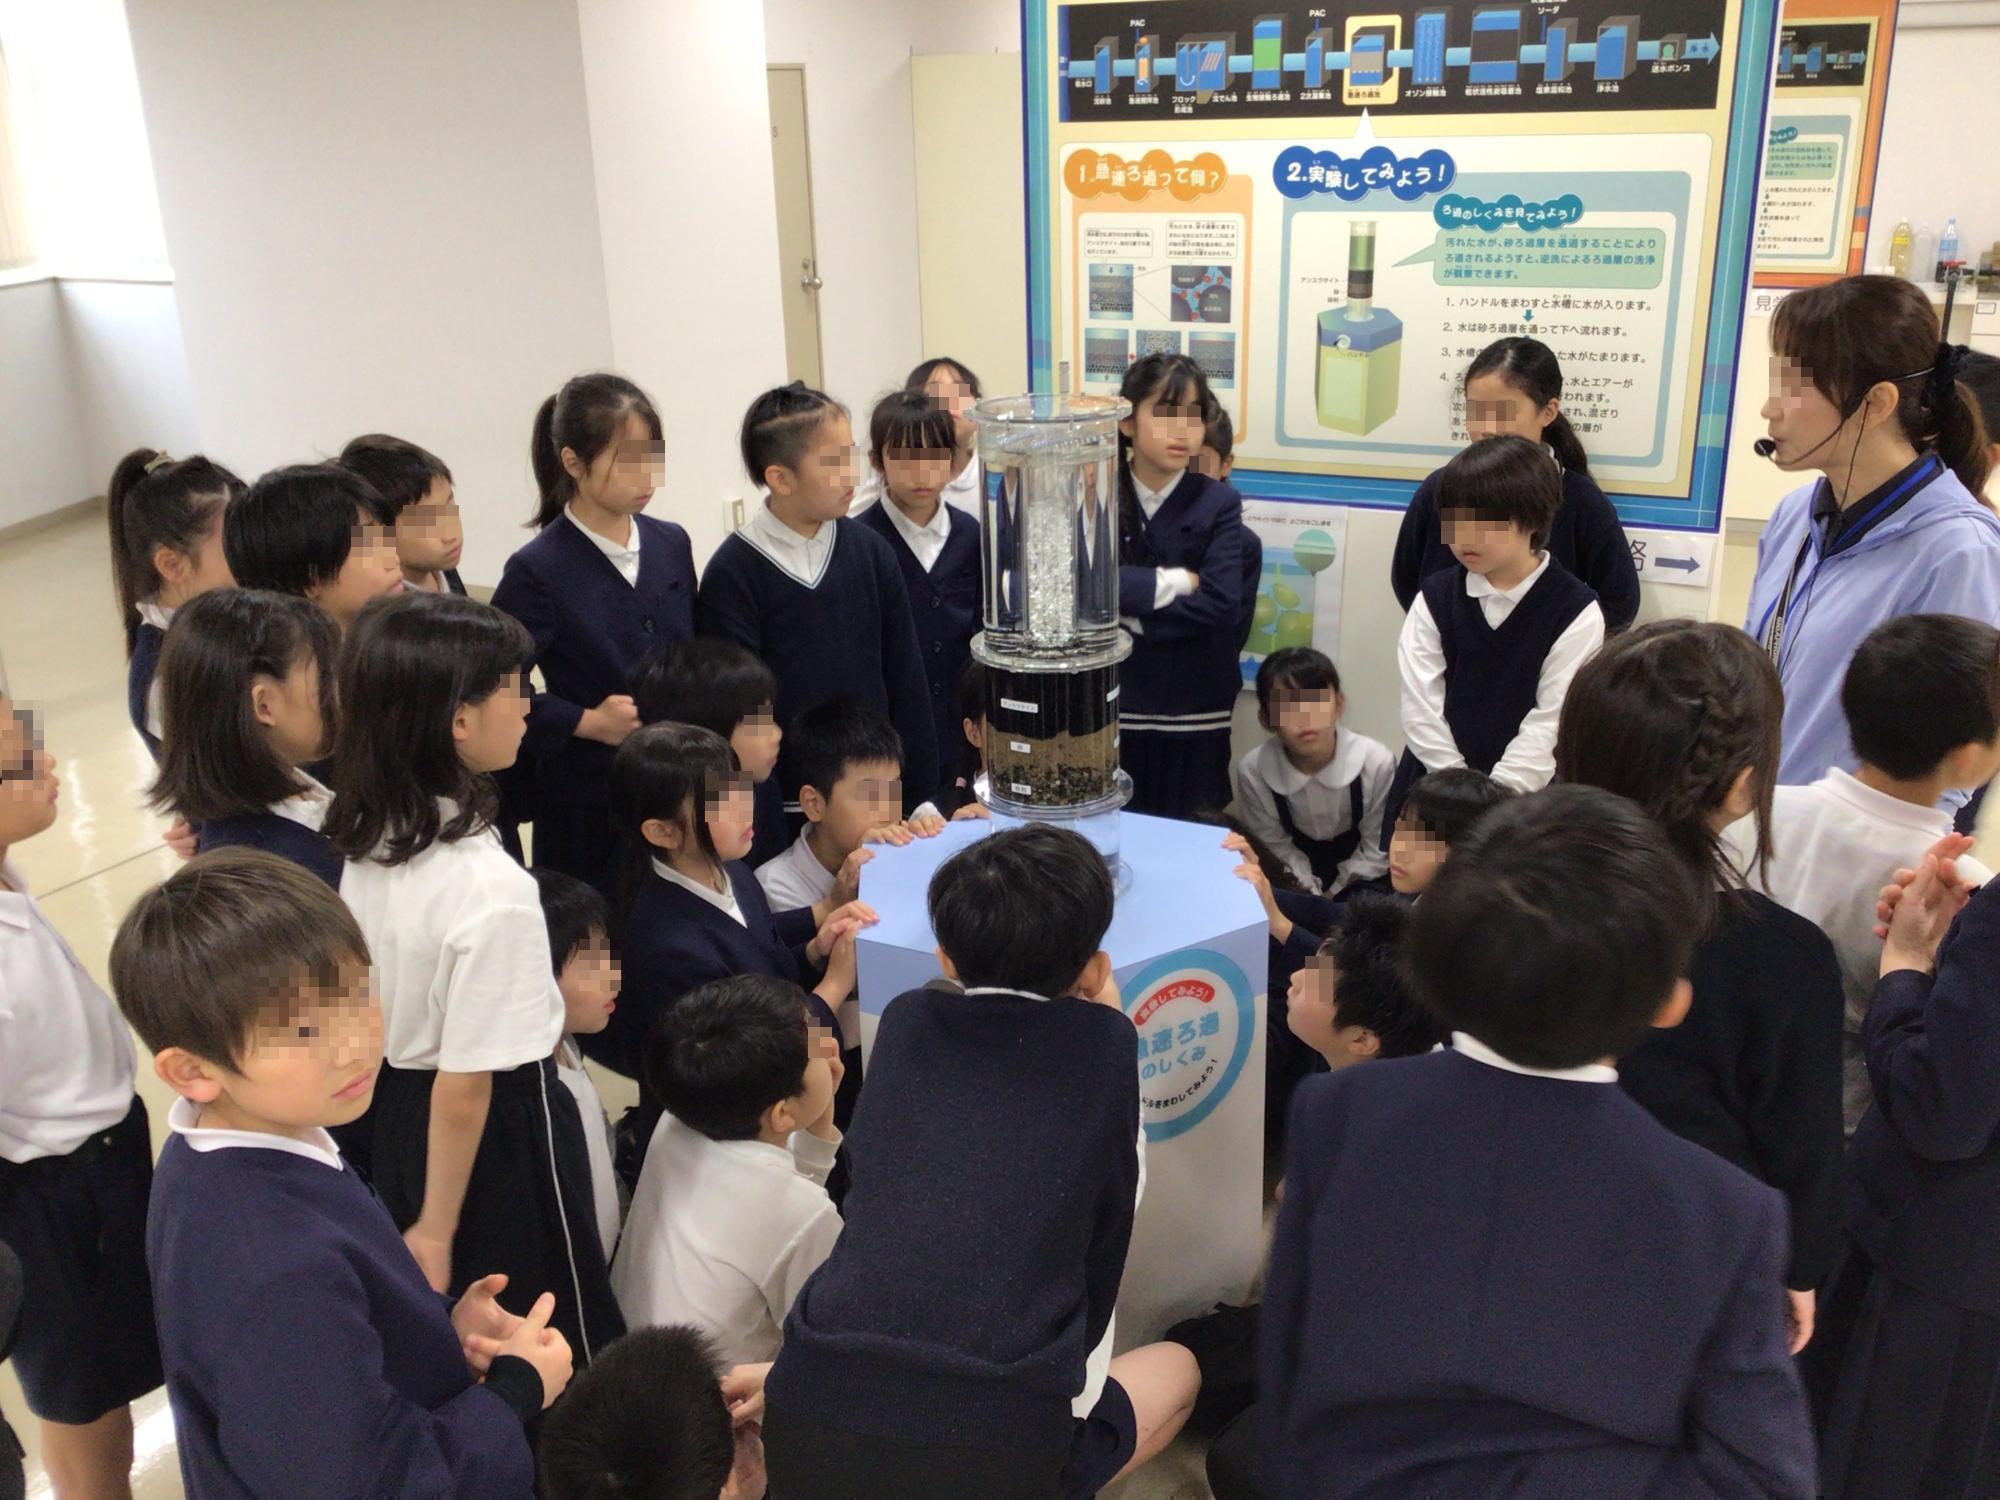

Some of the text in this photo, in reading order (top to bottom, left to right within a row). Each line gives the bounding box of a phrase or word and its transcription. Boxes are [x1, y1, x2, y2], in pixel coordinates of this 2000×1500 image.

[1309, 9, 1326, 17] PAC
[1537, 5, 1560, 15] ソーダ
[1130, 19, 1145, 27] PAC
[1172, 96, 1196, 104] フロック
[1555, 351, 1646, 364] た水がたまります。
[1562, 377, 1633, 389] 、水とエアーが
[1561, 392, 1610, 403] われます。
[1141, 1046, 1206, 1080] のしくみ
